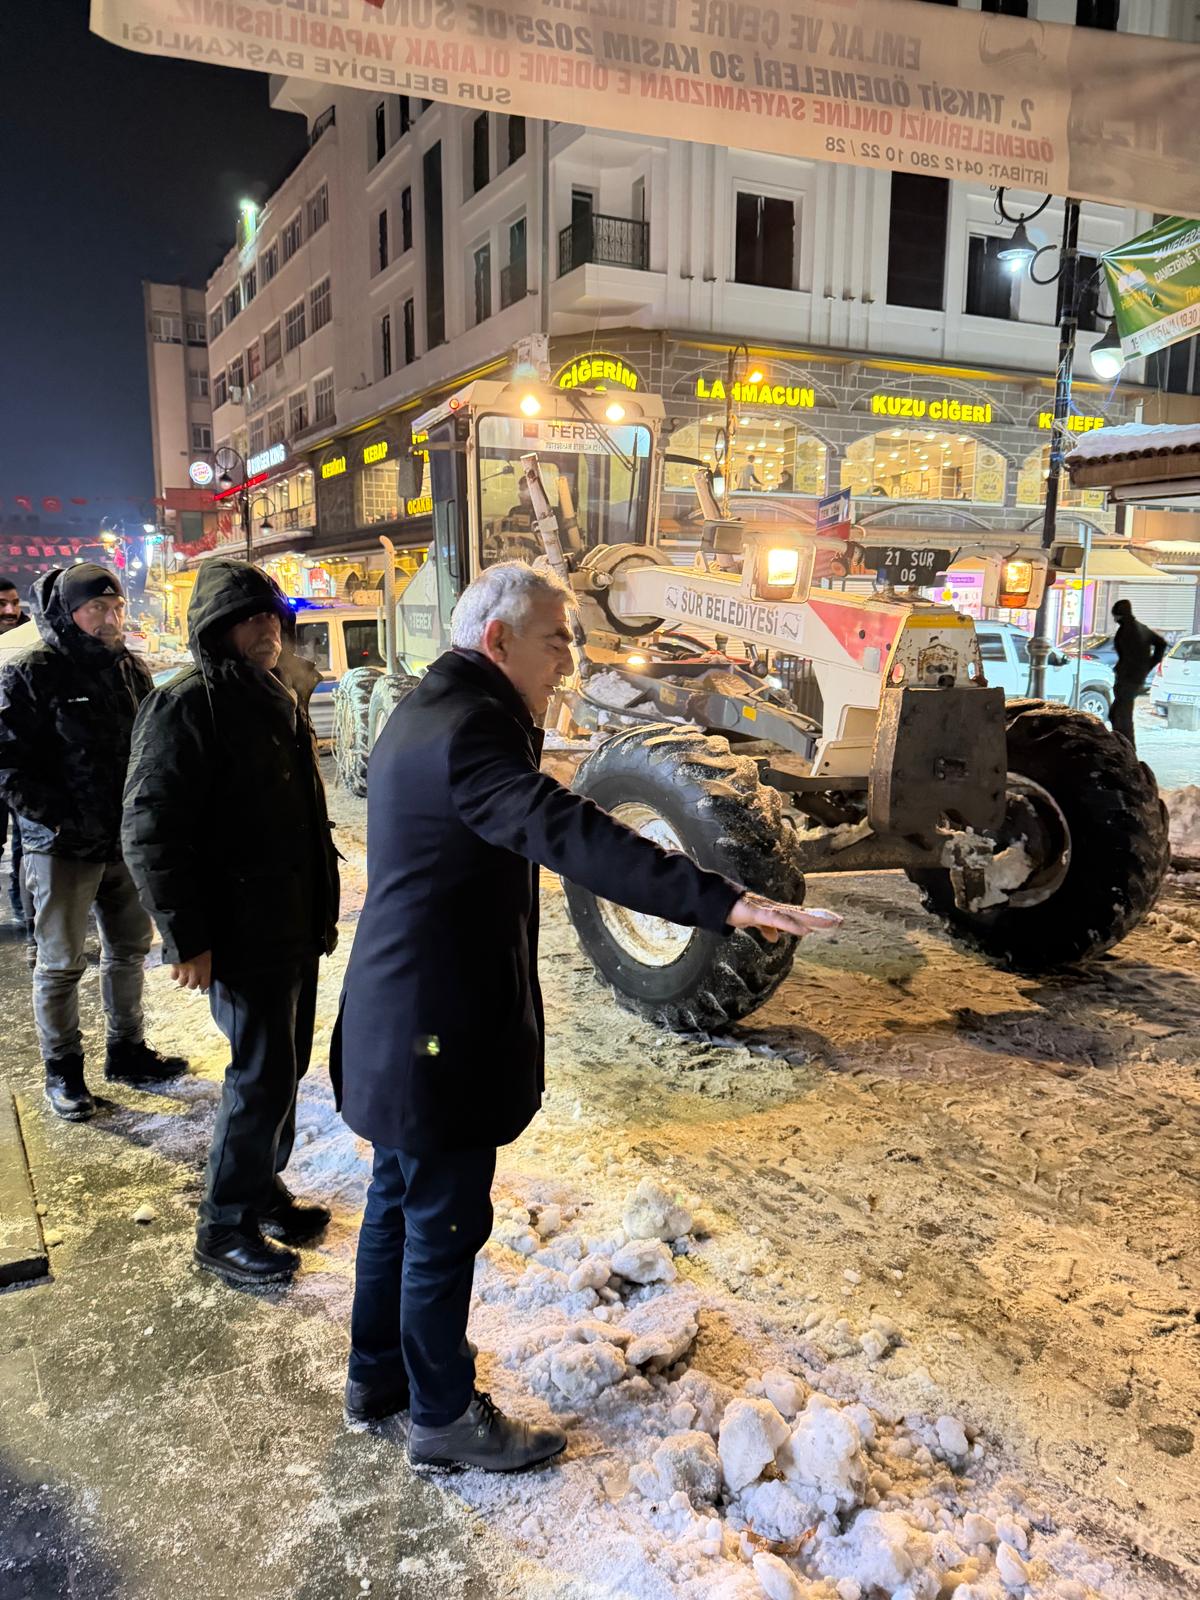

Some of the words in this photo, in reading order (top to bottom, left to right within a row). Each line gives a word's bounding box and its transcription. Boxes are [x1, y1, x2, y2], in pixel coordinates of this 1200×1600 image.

[872, 395, 926, 417] KUZU
[928, 399, 992, 423] CİĞERİ
[364, 441, 388, 464] KEBAP
[884, 551, 901, 566] 21
[911, 551, 936, 567] SUR
[901, 568, 917, 583] 06
[680, 590, 703, 617] SUR
[705, 595, 779, 636] BELEDİYESİ
